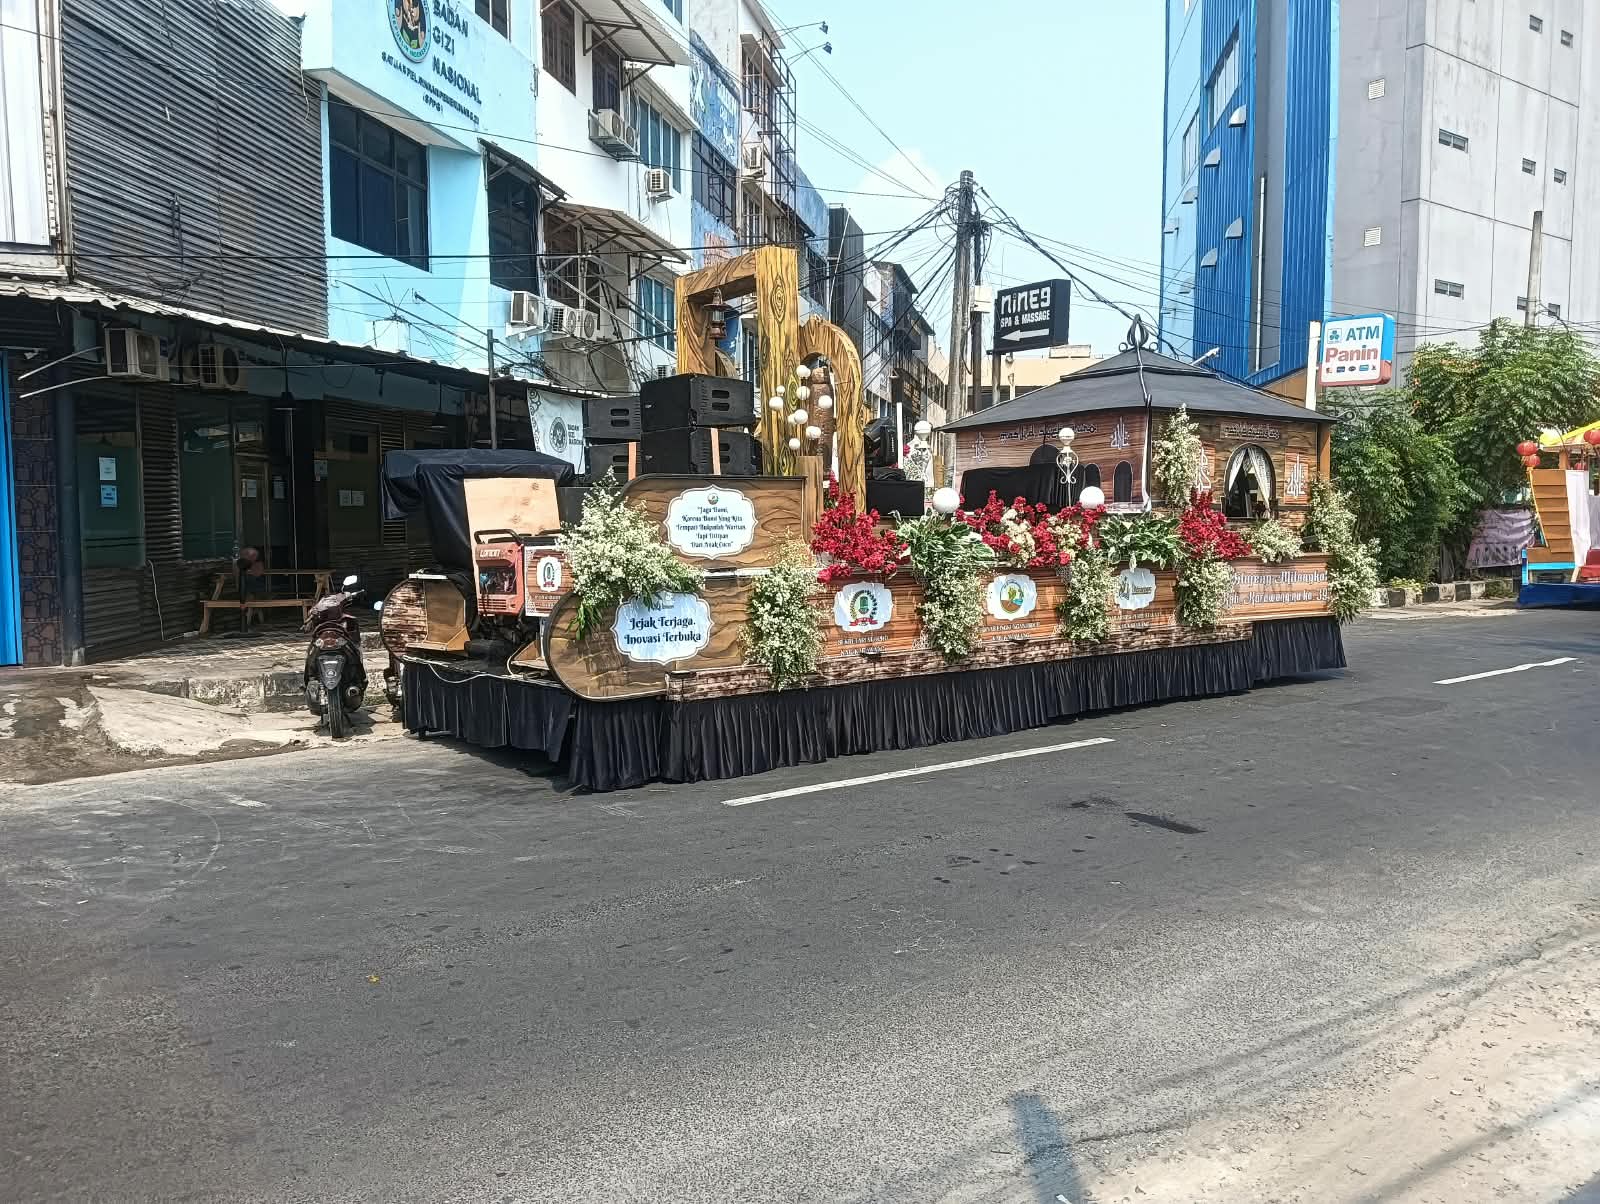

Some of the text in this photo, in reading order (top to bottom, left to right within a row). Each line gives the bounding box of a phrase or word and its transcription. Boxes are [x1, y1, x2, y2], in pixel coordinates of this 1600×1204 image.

[433, 0, 468, 37] BADAN
[432, 25, 455, 56] GIZI
[432, 54, 482, 105] NASIONAL
[1000, 310, 1050, 328] SPA & MASSAGE
[1345, 325, 1380, 341] ATM
[1325, 344, 1378, 363] Panin
[629, 616, 696, 630] Jejak Terjaga.
[624, 631, 702, 645] Inovasi Terbuka
